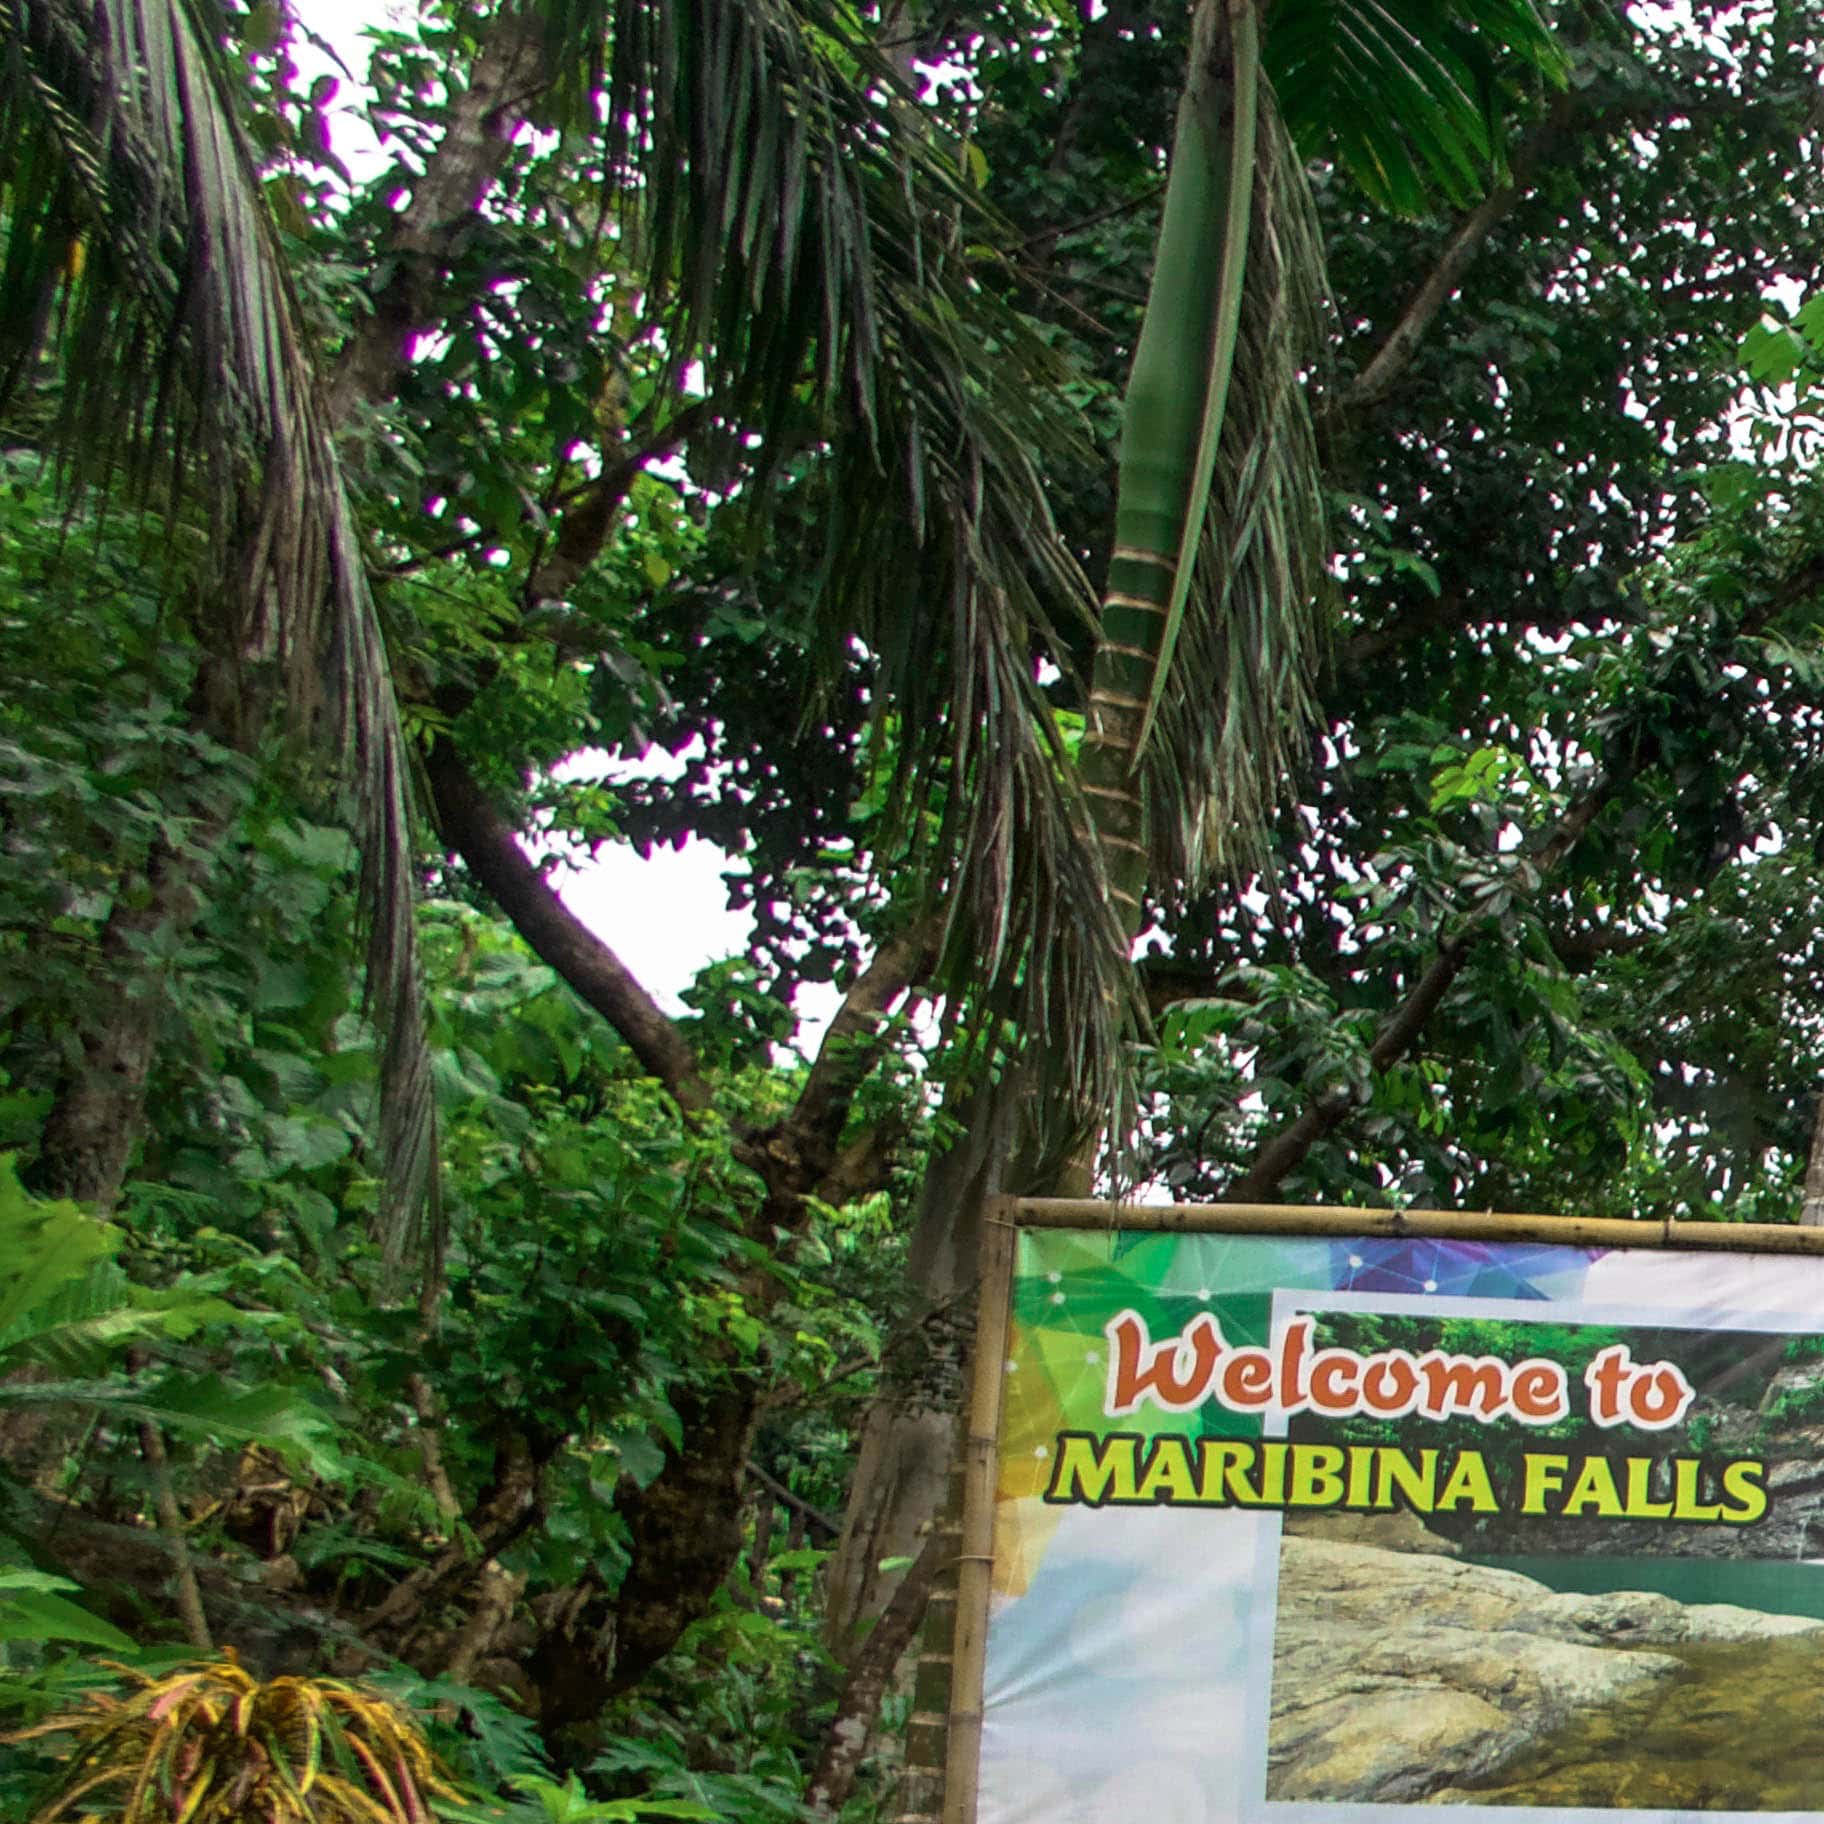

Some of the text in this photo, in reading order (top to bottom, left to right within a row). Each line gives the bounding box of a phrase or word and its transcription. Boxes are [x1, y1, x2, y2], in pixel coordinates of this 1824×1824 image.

[1108, 1312, 1690, 1427] Welcome to
[1050, 1437, 1768, 1523] MARIBINA FALLS
